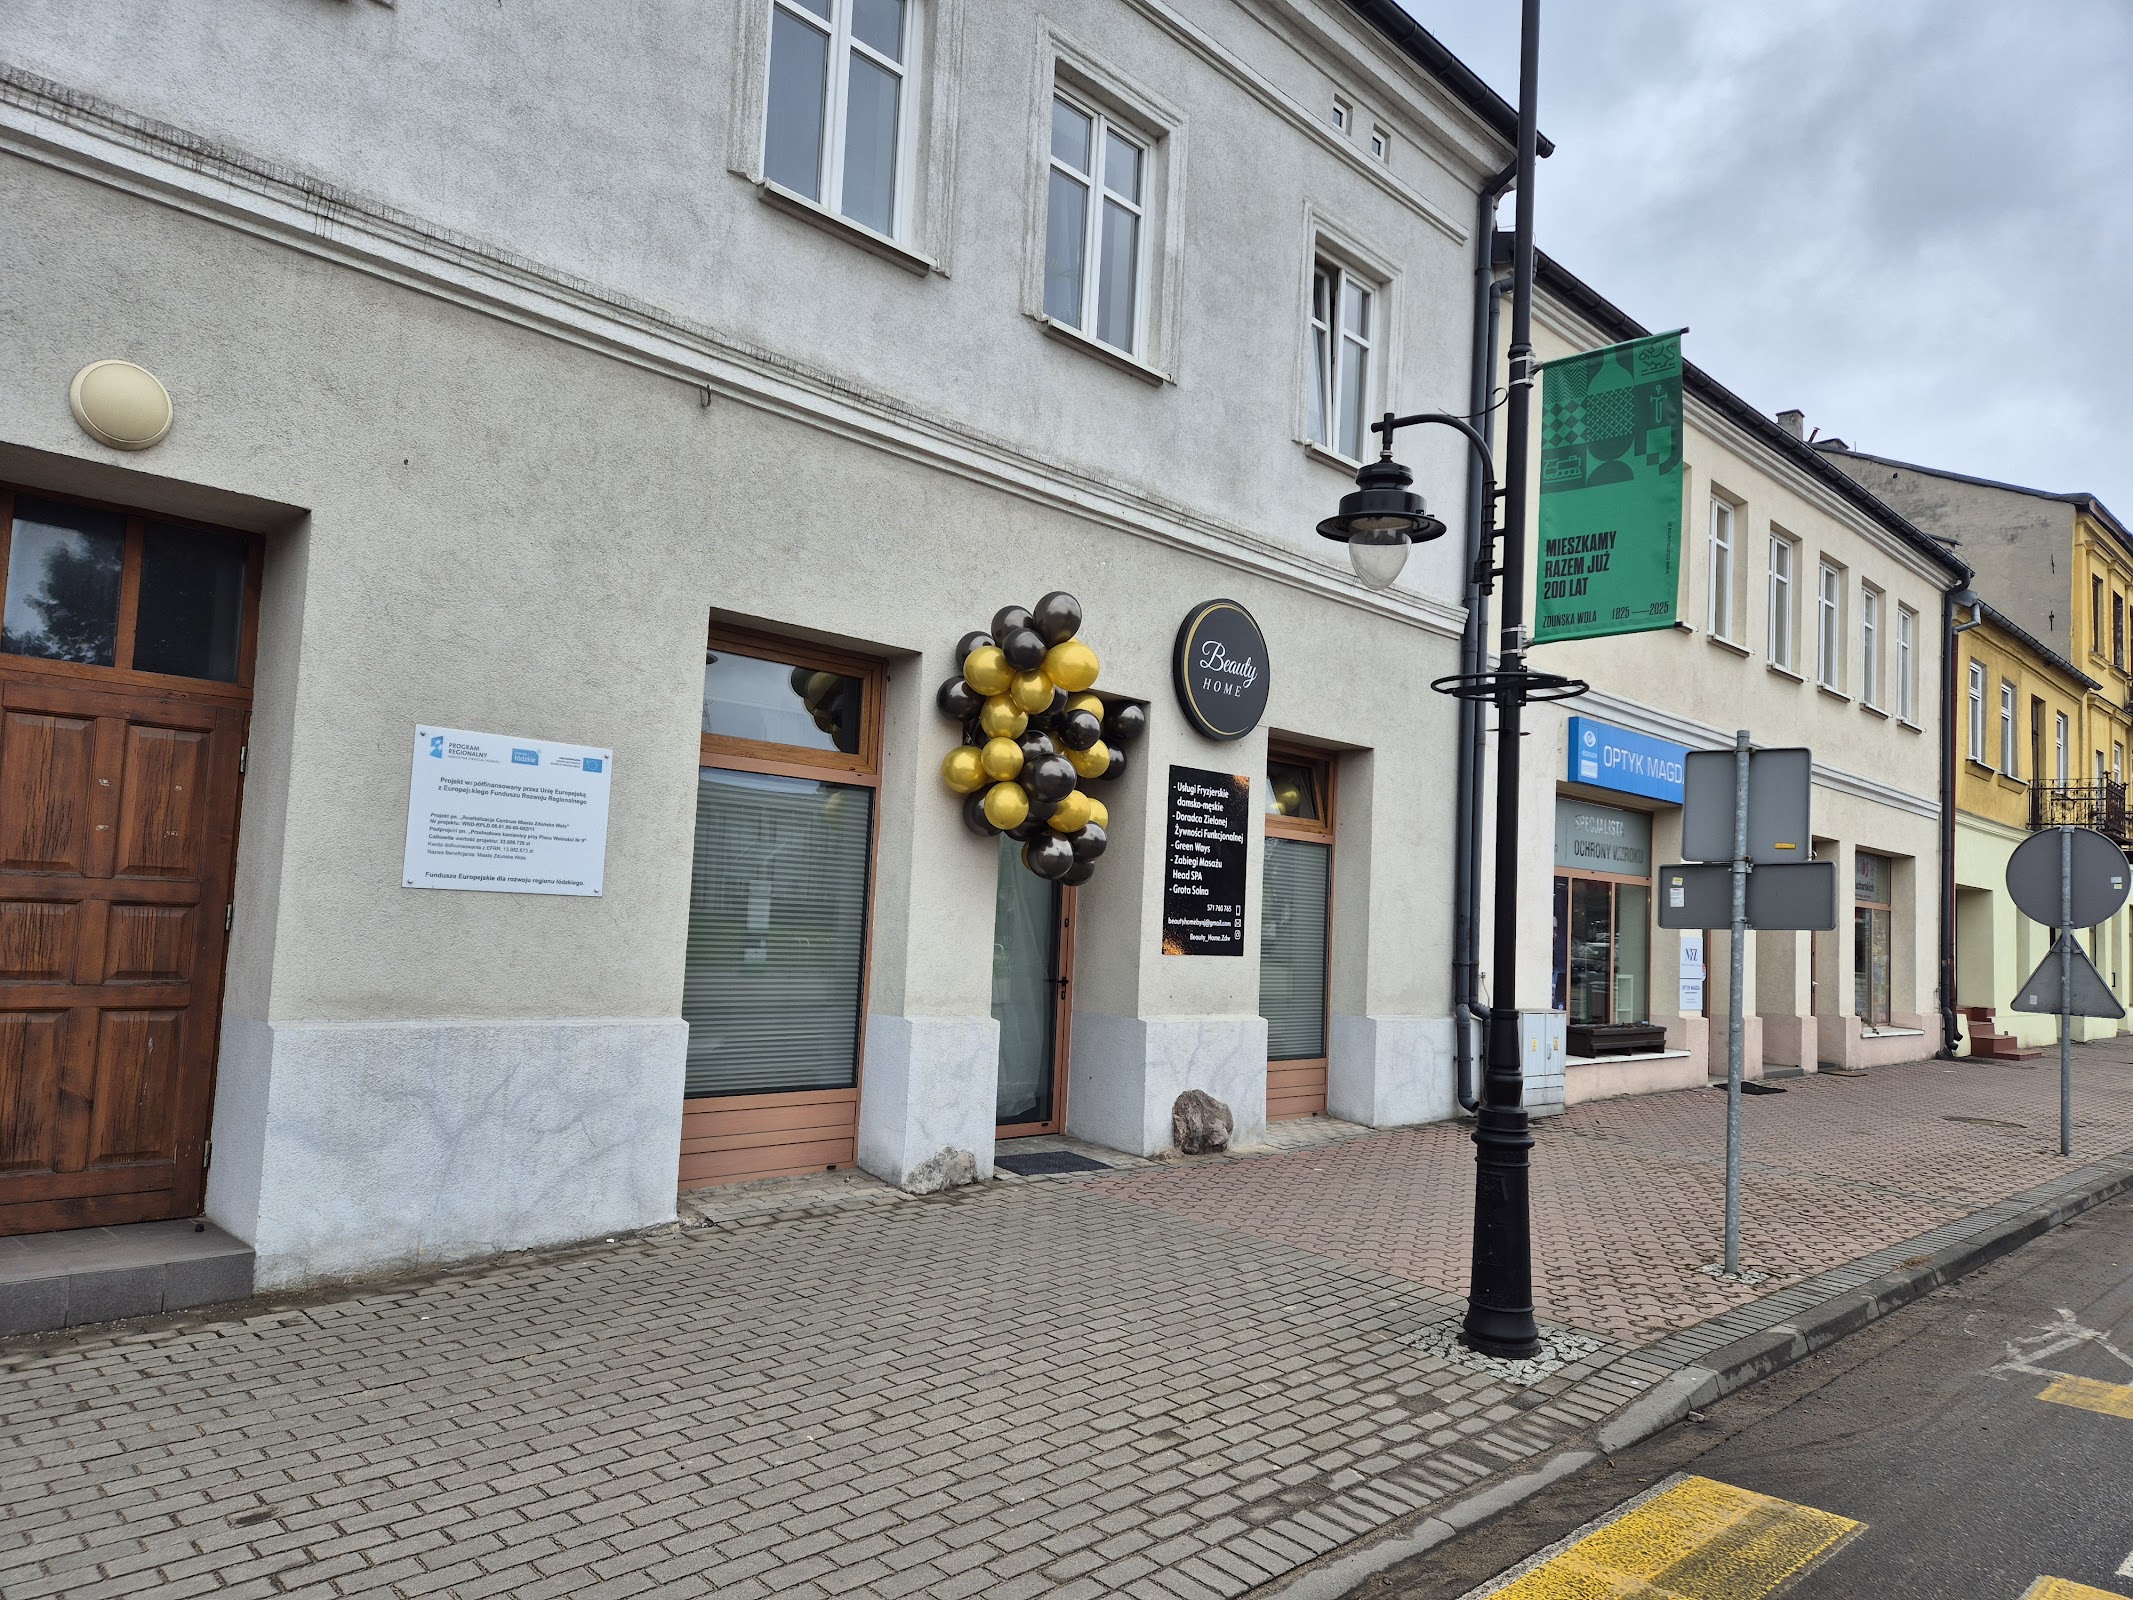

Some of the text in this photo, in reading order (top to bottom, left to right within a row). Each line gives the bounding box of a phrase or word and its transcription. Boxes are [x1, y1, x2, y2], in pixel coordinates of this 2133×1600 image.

[1545, 530, 1617, 557] MIESZKAMY
[1544, 550, 1610, 579] RAZEM JUŻ
[1543, 577, 1589, 600] 200 LAT
[1542, 611, 1575, 628] ZDUŃSKA
[1577, 610, 1597, 624] WOLA
[1612, 606, 1630, 620] 1825
[1649, 601, 1669, 616] 2025
[1200, 640, 1258, 689] Beauty
[1202, 678, 1242, 698] HOME
[448, 742, 480, 752] PROGRAM
[448, 748, 488, 759] REGIONALNY
[1603, 745, 1685, 785] OPTYK MAGD
[440, 776, 587, 799] Projekt współfinansowany przez Unię Europejską
[443, 784, 489, 796] Europejskiego
[490, 789, 521, 799] Funduszu
[521, 792, 547, 802] Rozwoju
[548, 795, 588, 806] Regionalnego
[1177, 782, 1197, 796] Usługi
[1197, 785, 1230, 799] Fryzjerskie
[1177, 796, 1224, 813] damsko-męskie
[1176, 811, 1203, 824] Doradca
[1203, 814, 1228, 829] Zielonej
[1174, 823, 1244, 845] Żywności Funkcjonalnej
[1174, 840, 1194, 851] Green
[1194, 842, 1211, 855] Ways
[1574, 840, 1611, 860] OCHRONY
[1173, 854, 1199, 869] Zabiegi
[1199, 856, 1223, 869] Masażu
[425, 871, 457, 880] Fundusze
[458, 873, 496, 882] Europejskie
[507, 876, 532, 885] rozwoju
[532, 878, 555, 886] regionu
[1172, 868, 1203, 881] Head SPA
[1172, 883, 1191, 895] Grota
[1191, 885, 1209, 896] Solna
